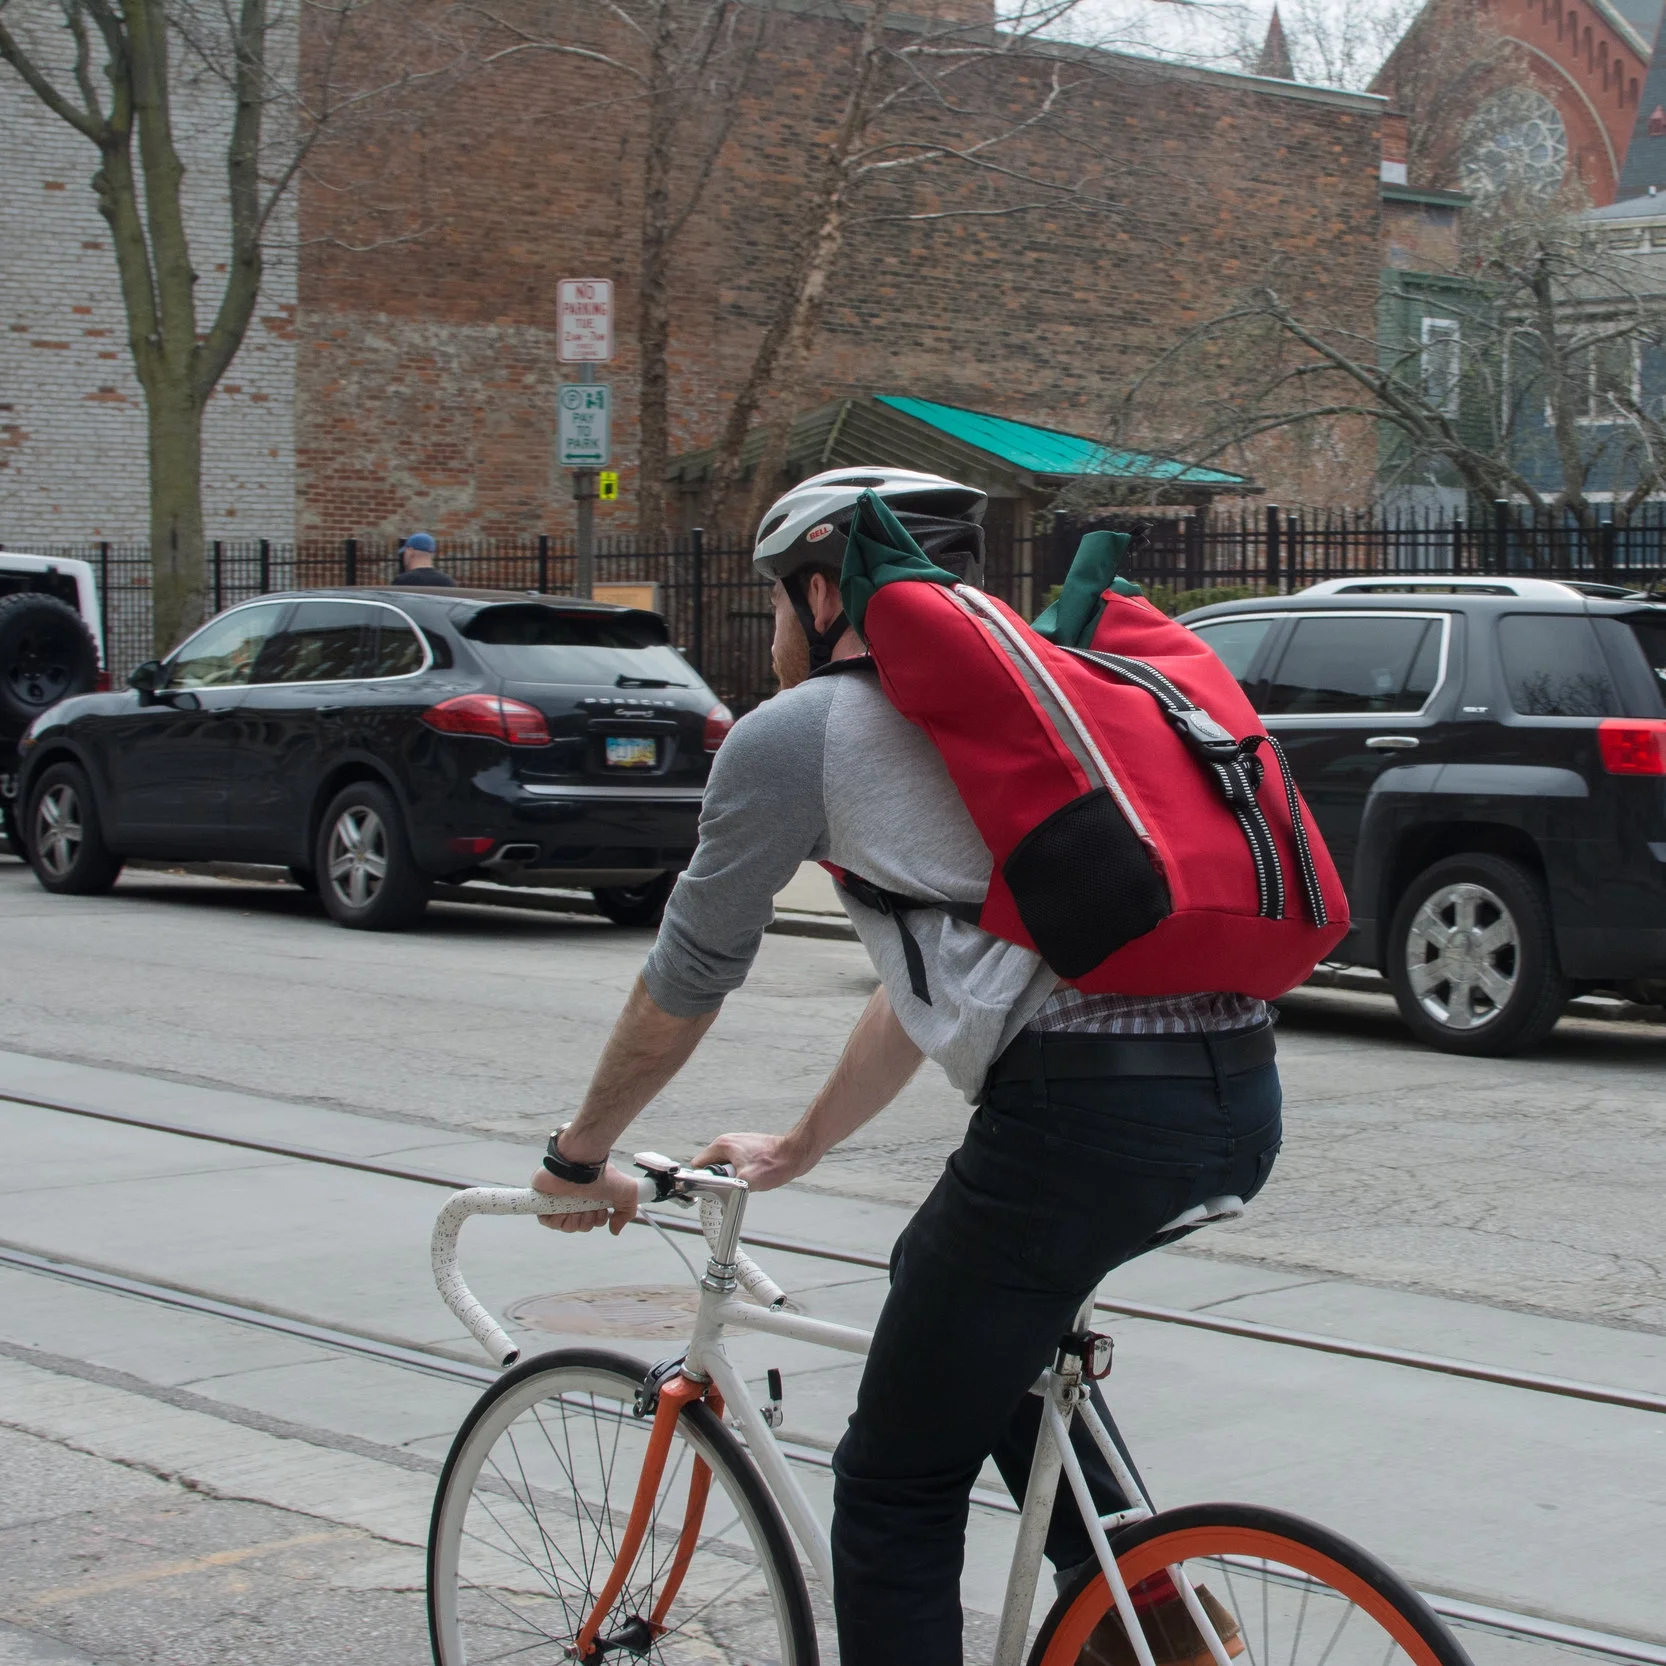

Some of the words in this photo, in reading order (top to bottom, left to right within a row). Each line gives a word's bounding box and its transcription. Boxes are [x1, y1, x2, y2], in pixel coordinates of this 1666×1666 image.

[575, 285, 595, 299] NO
[563, 303, 608, 315] PARKING
[572, 412, 595, 423] PAY
[577, 425, 591, 437] TO
[566, 438, 599, 449] PARK
[809, 527, 829, 540] BELL
[584, 698, 676, 706] PORSCHE
